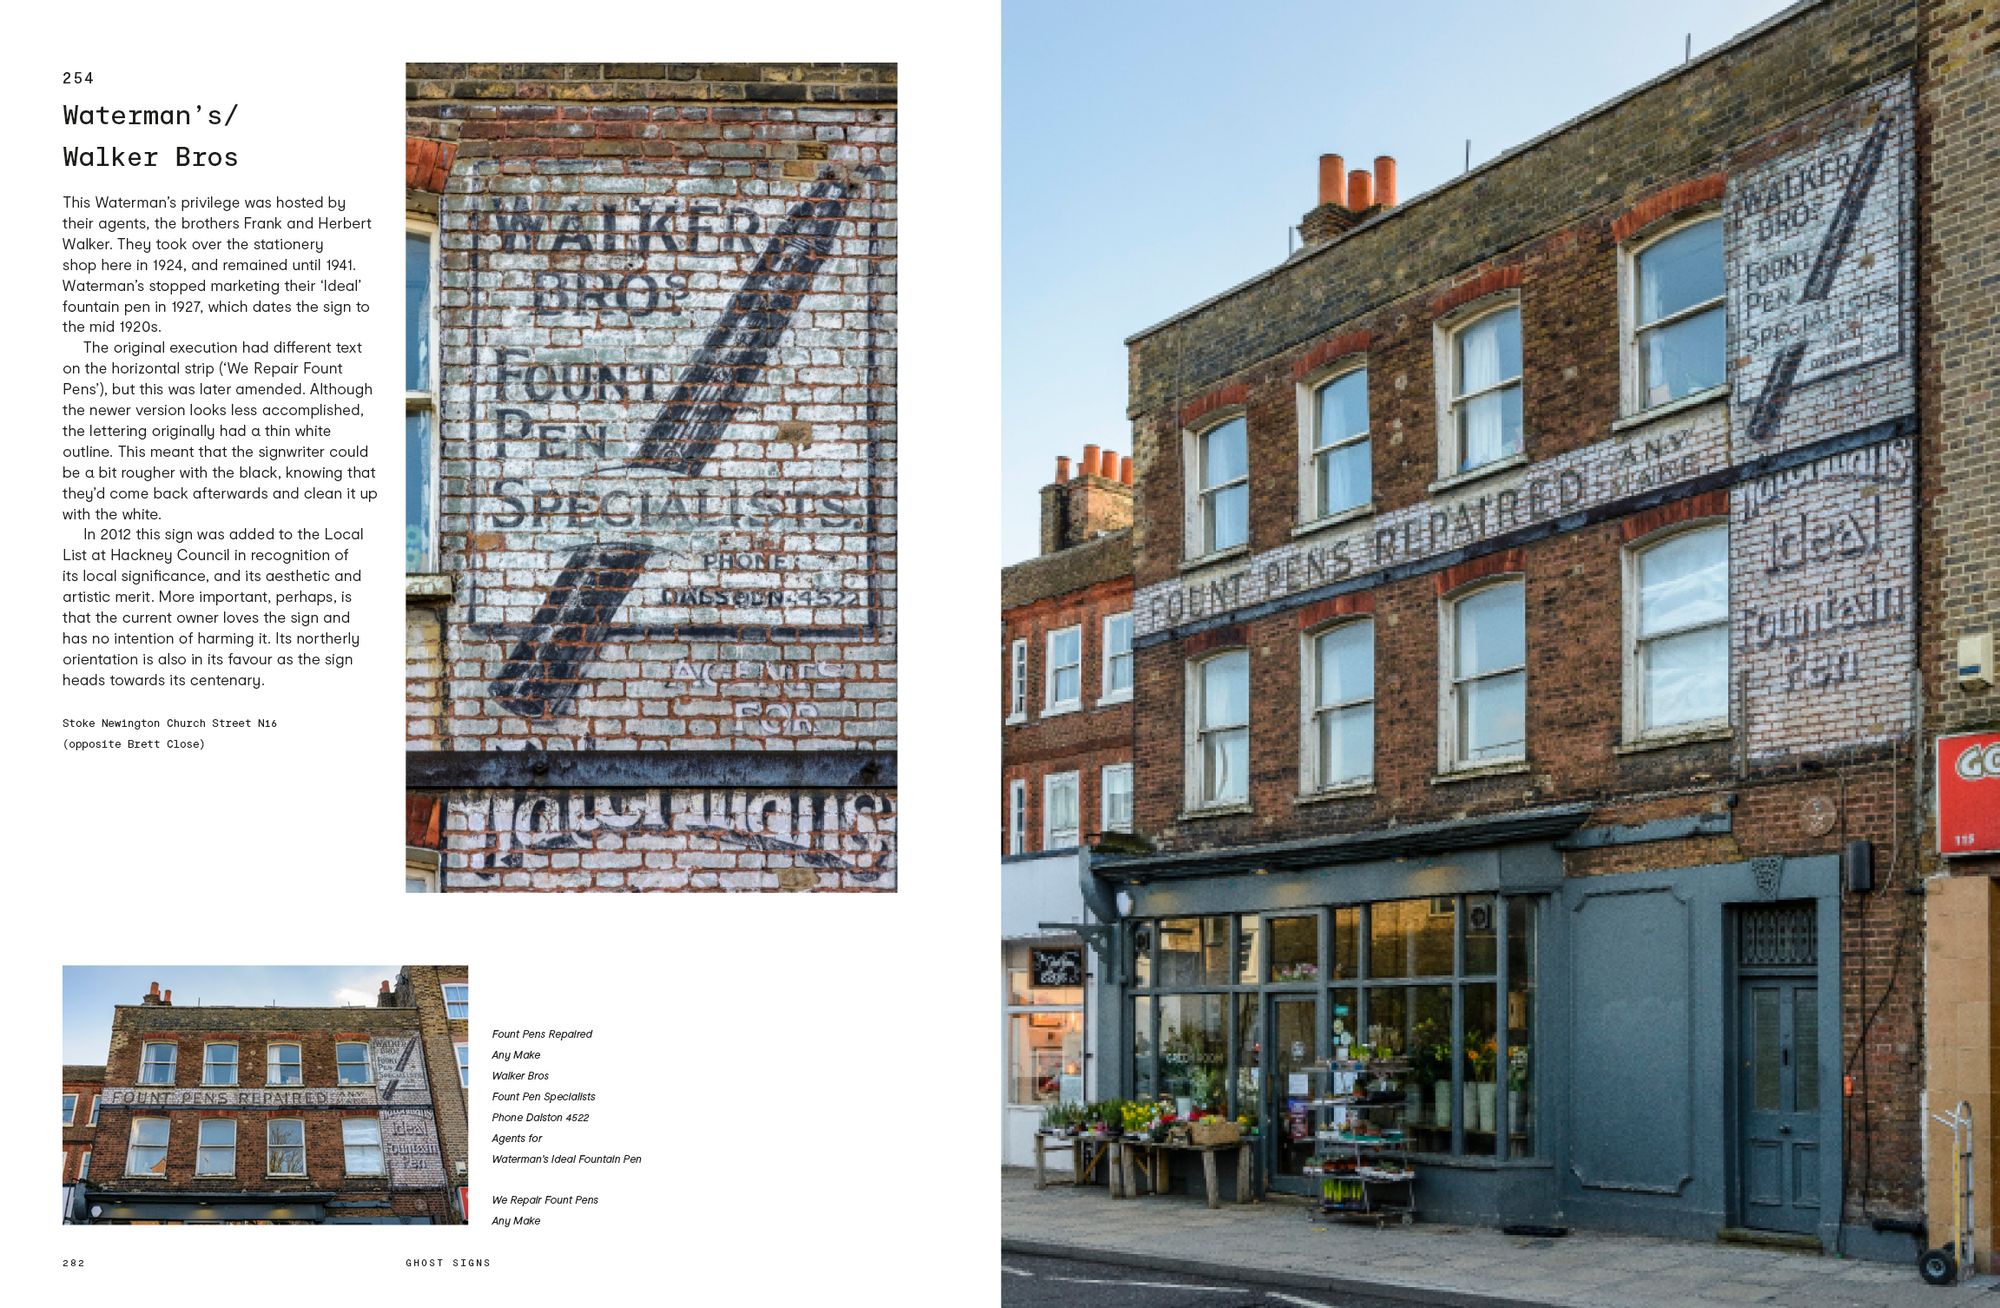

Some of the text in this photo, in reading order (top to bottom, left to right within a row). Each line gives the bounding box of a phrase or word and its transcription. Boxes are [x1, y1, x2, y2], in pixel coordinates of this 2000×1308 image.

[62, 71, 94, 85] 254
[62, 103, 239, 127] Waterman’s/
[62, 146, 238, 167] Walker Bros
[62, 195, 346, 212] This Waterman’s privilege was hosted by
[494, 197, 758, 253] WALKER
[61, 237, 324, 254] Walker. They took over the stationery
[61, 279, 362, 296] Waterman’s stopped marketing their ‘Ideal’
[61, 319, 162, 333] the mid 1920s.
[83, 340, 363, 357] The original execution had different text
[62, 360, 343, 378] on the horizontal strip (‘We Repair Fount
[496, 348, 666, 401] FOUNT
[63, 381, 373, 399] Pens’), but this was later amended. Although
[496, 407, 607, 460] PEN
[62, 465, 376, 482] be a bit rougher with the black, knowing that
[84, 527, 364, 544] In 2012 this sign was added to the Local
[63, 548, 349, 565] List at Hackney Council in recognition of
[1151, 469, 1582, 631] FOUNT PENS REPAIRED
[62, 673, 265, 690] heads towards its centenary.
[63, 718, 277, 731] Stoke Newington Church Street N16
[731, 701, 821, 734] FOR
[63, 738, 205, 751] (opposite Brett Close)
[492, 1029, 594, 1042] Fount Pens Repaired
[491, 1050, 540, 1063] Any Make
[493, 1070, 550, 1081] Walker Bros
[112, 1091, 327, 1105] FOUNT PENS REPAIRED
[491, 1091, 597, 1104] Fount Pen Specialists
[492, 1112, 589, 1122] Phone Dalston 4522
[490, 1133, 543, 1146] Agents for
[551, 1154, 576, 1163] Ideal
[579, 1154, 620, 1163] Fountain
[623, 1154, 641, 1163] Pen
[493, 1195, 598, 1207] We Repair Fount Pens
[491, 1216, 540, 1228] Any Make
[63, 1258, 84, 1267] 282
[406, 1258, 489, 1267] GHOST SIGNS
